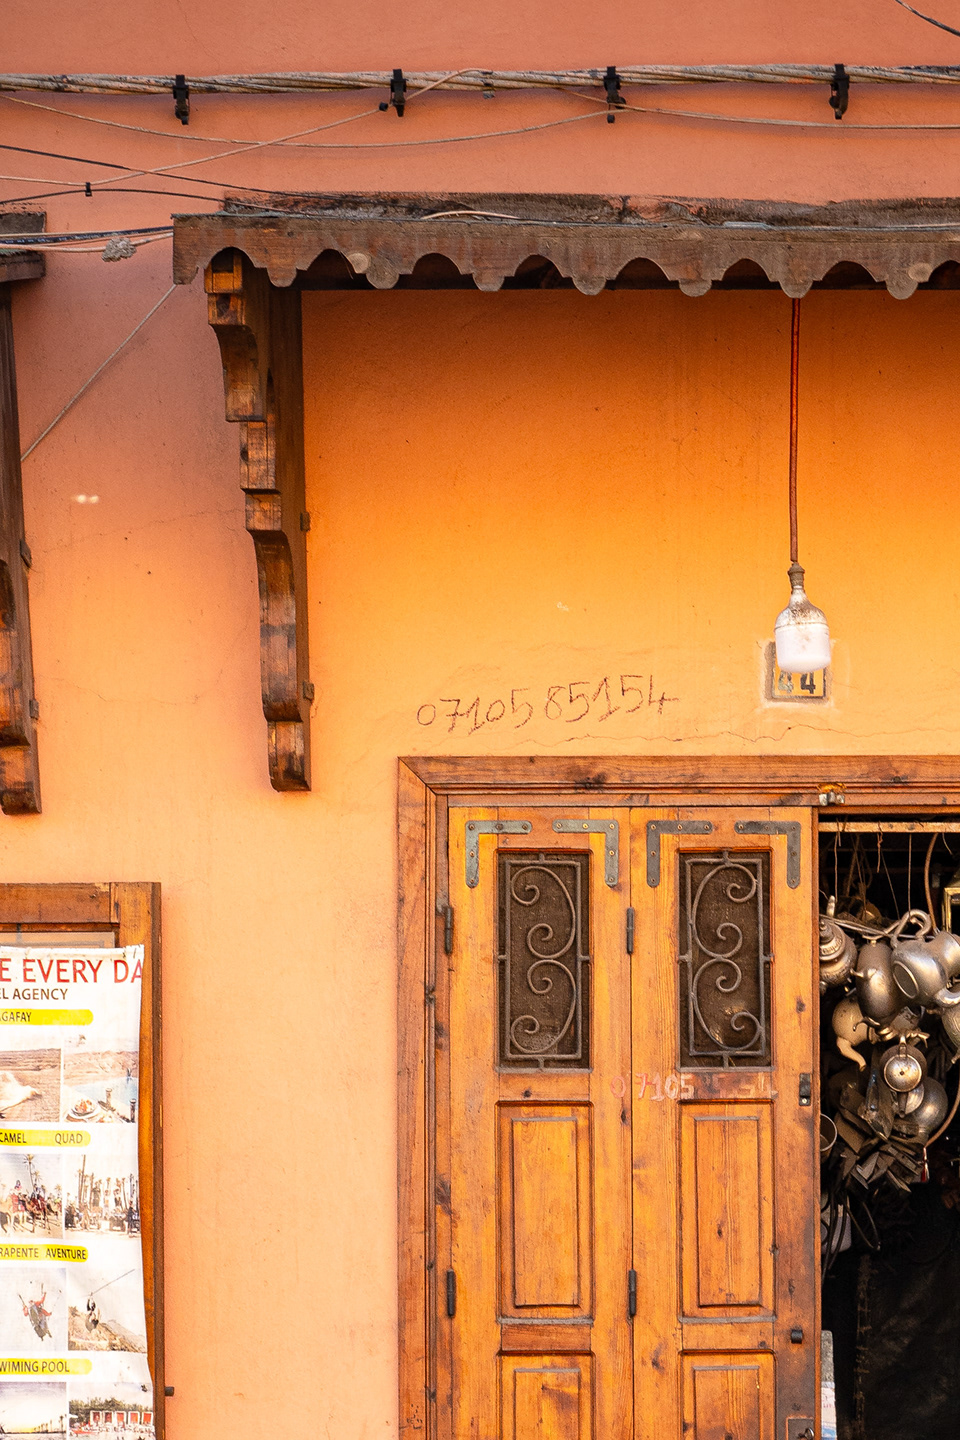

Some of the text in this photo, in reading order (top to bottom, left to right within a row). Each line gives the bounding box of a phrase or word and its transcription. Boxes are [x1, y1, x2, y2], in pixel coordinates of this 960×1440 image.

[23, 959, 103, 983] EVERY
[0, 988, 68, 1000] L AGENCY
[0, 1011, 32, 1022] GAFAY
[54, 1133, 83, 1145] QUAD
[46, 1248, 87, 1260] AVENTURE
[41, 1361, 70, 1373] POOL
